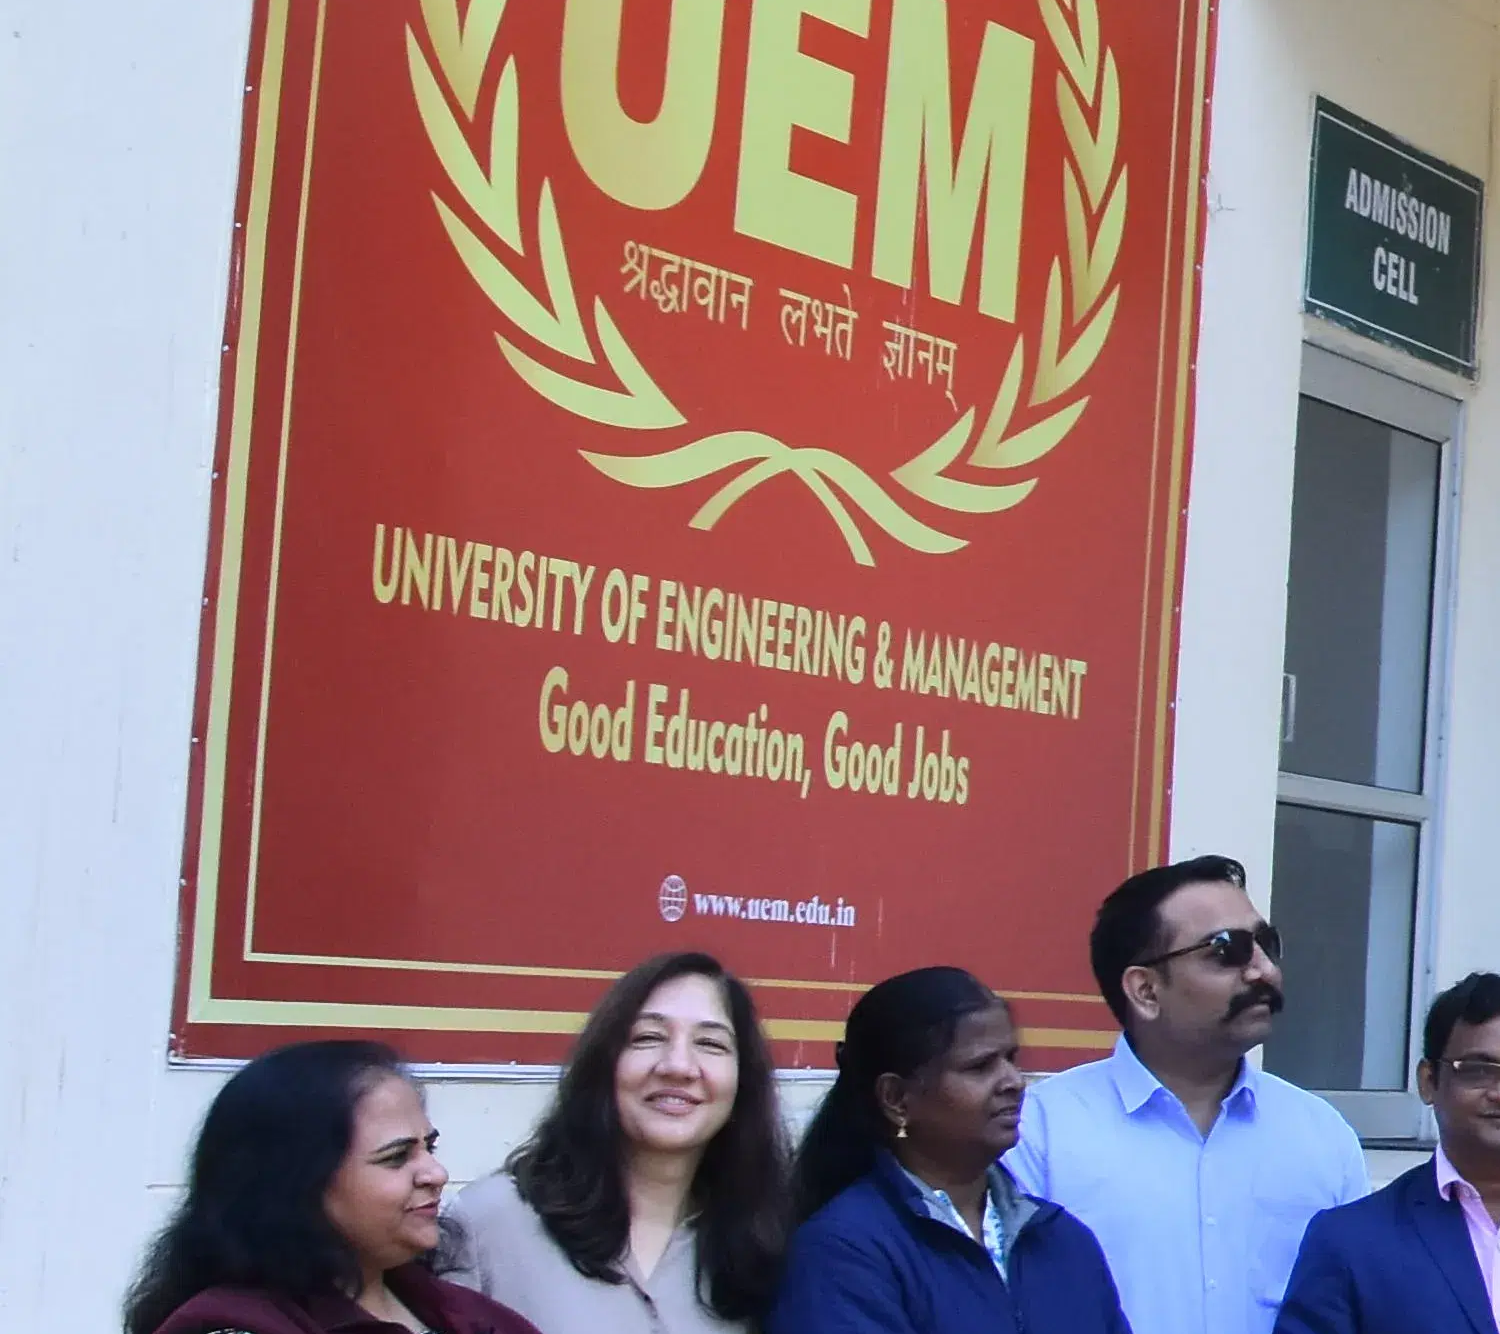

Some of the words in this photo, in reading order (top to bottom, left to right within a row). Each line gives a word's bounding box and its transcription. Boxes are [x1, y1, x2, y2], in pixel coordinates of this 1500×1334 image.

[1344, 167, 1450, 255] ADMISSION
[1373, 246, 1418, 305] CELL
[372, 523, 595, 635] UNIVERSITY
[600, 568, 650, 645] OF
[656, 580, 866, 685] ENGINEERING
[873, 620, 893, 689] &
[900, 628, 1087, 720] MANAGEMENT
[539, 666, 637, 762] Good
[645, 683, 812, 799] Education,
[823, 710, 903, 796] Good
[908, 725, 969, 805] Jobs
[693, 891, 856, 927] www.uem.edu.in
